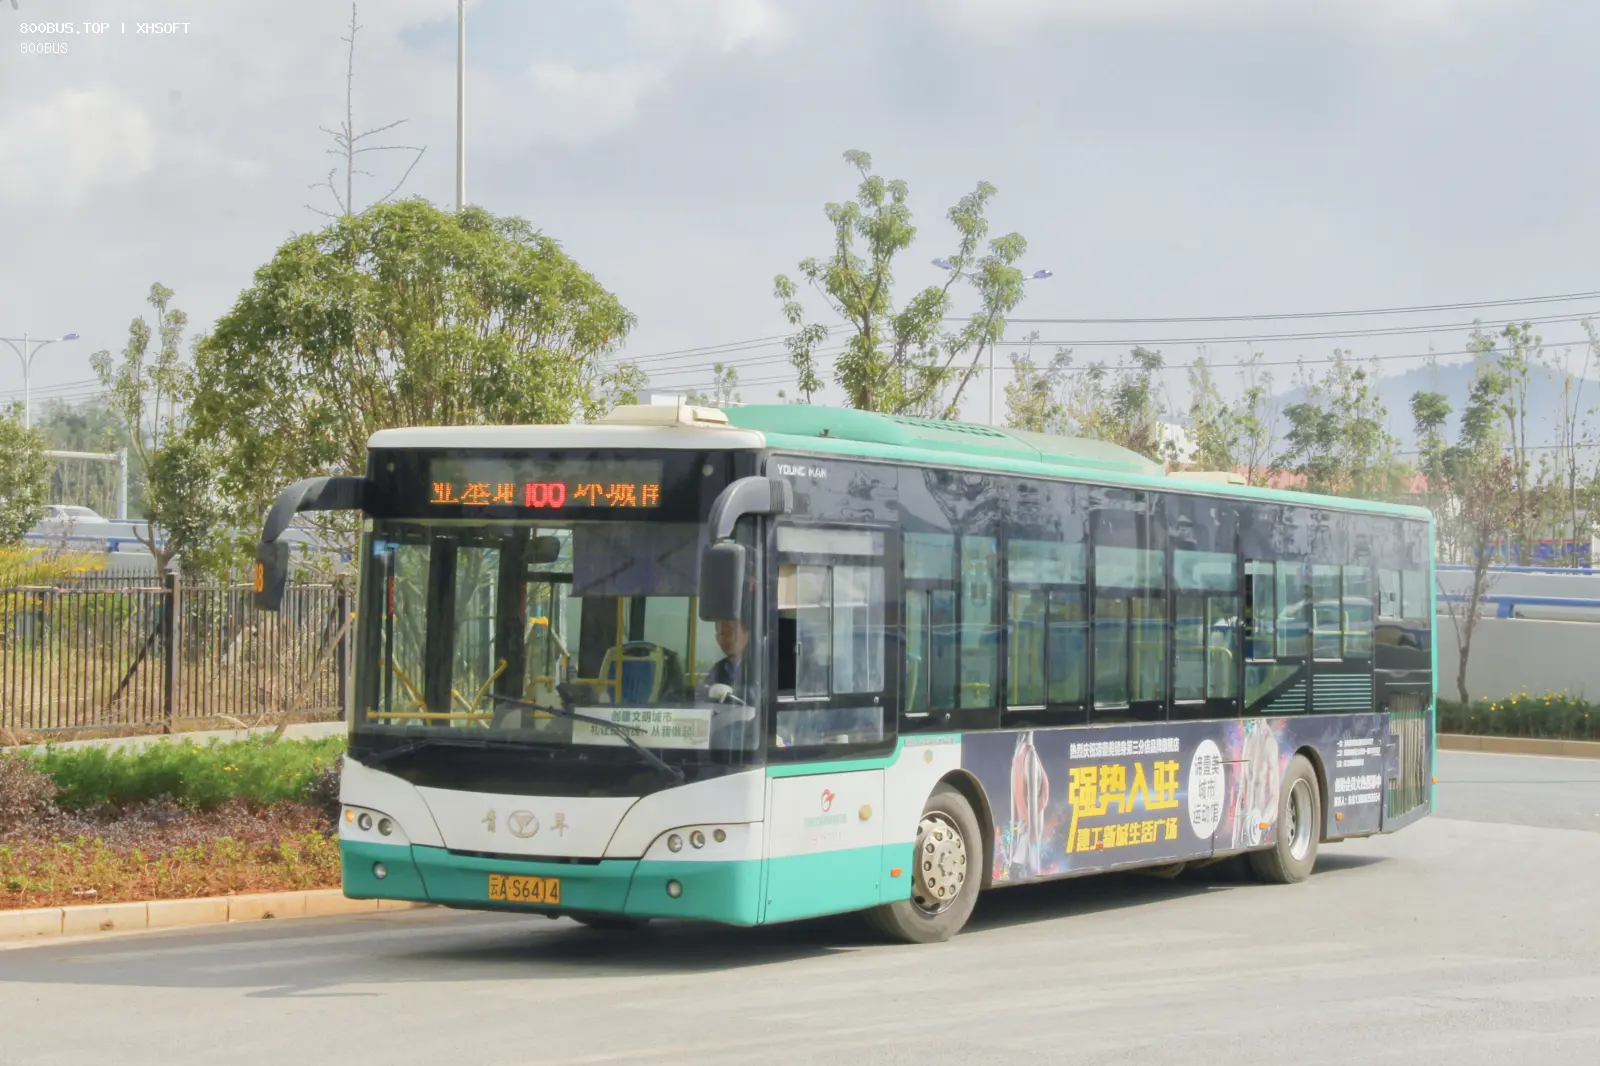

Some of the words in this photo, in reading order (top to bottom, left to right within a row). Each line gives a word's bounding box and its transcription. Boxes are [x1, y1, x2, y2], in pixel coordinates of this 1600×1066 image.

[777, 463, 807, 477] YOUNG
[808, 467, 828, 479] MAN
[525, 481, 567, 508] 100
[611, 710, 673, 724] 创建文明城市
[1198, 777, 1216, 801] 城市
[1066, 760, 1181, 853] 强势入驻
